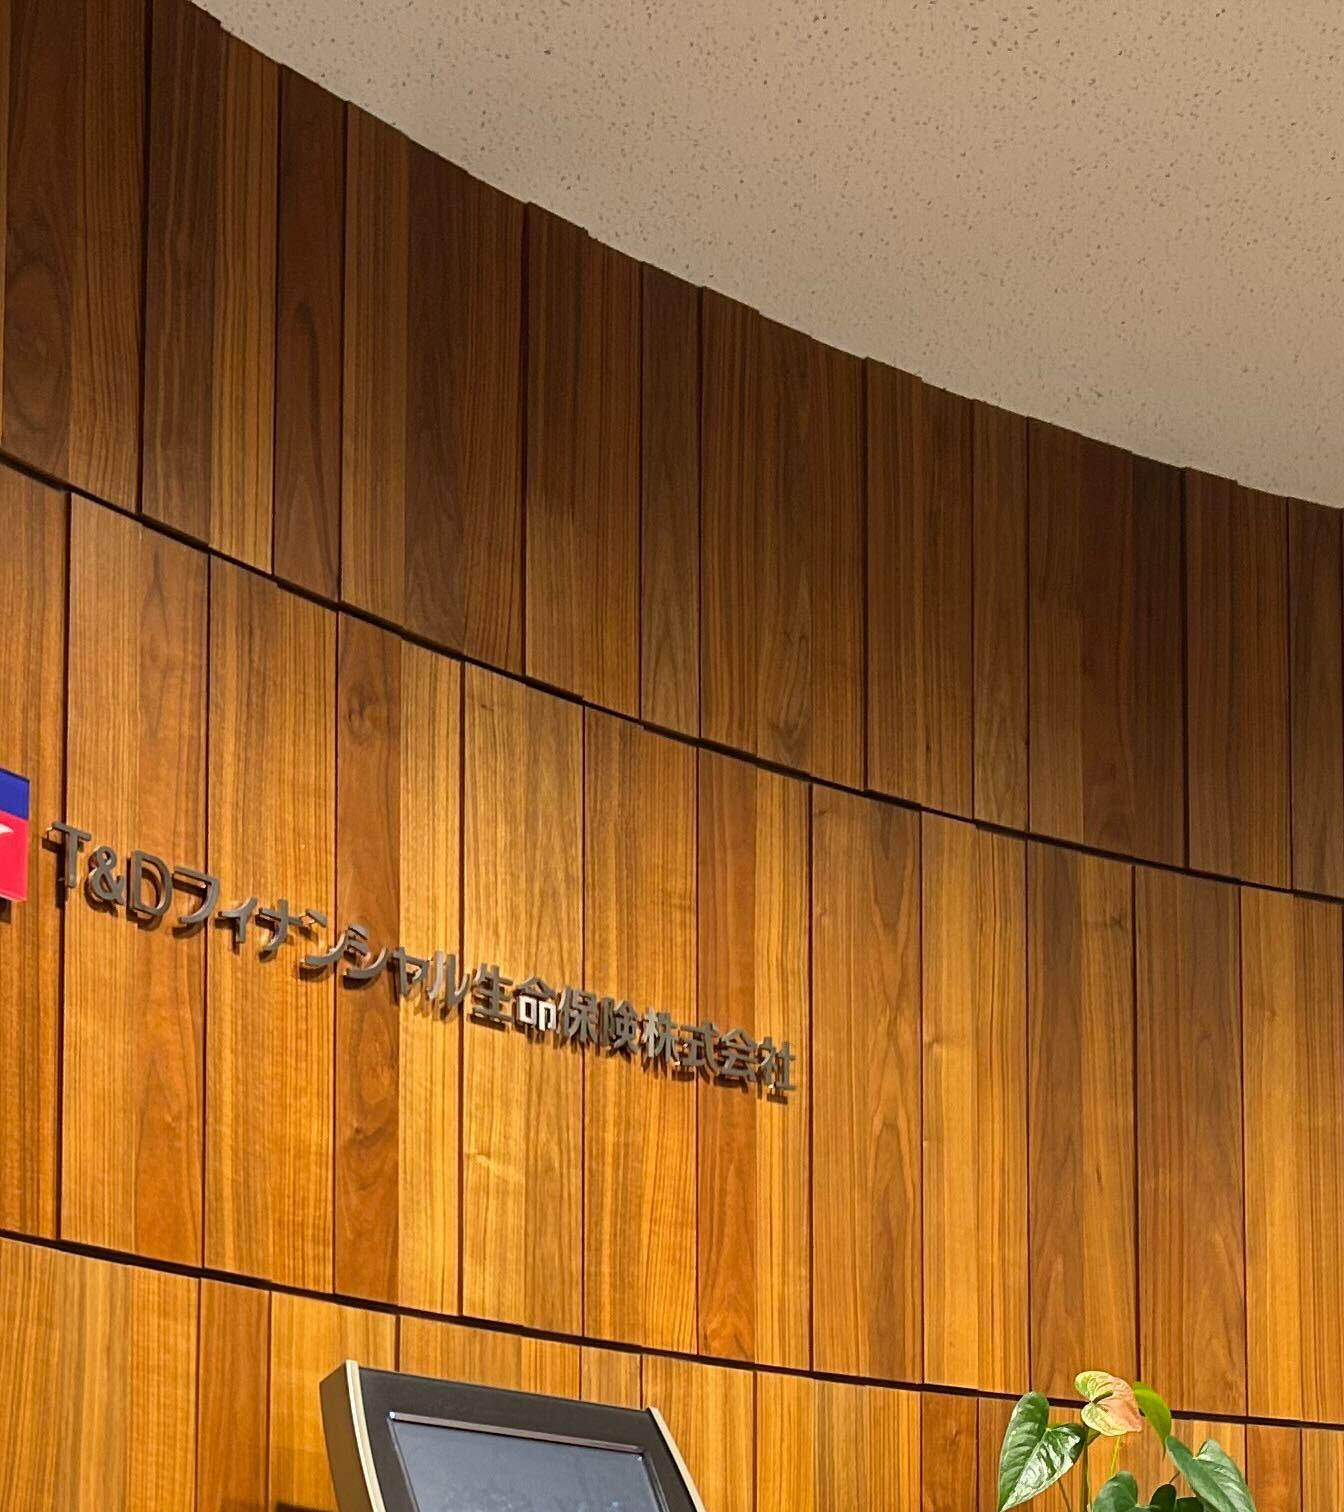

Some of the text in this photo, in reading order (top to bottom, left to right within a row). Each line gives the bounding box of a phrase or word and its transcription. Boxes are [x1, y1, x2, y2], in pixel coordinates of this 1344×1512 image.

[49, 821, 796, 1092] T&Dフィナンシャル生命保険株式会社
